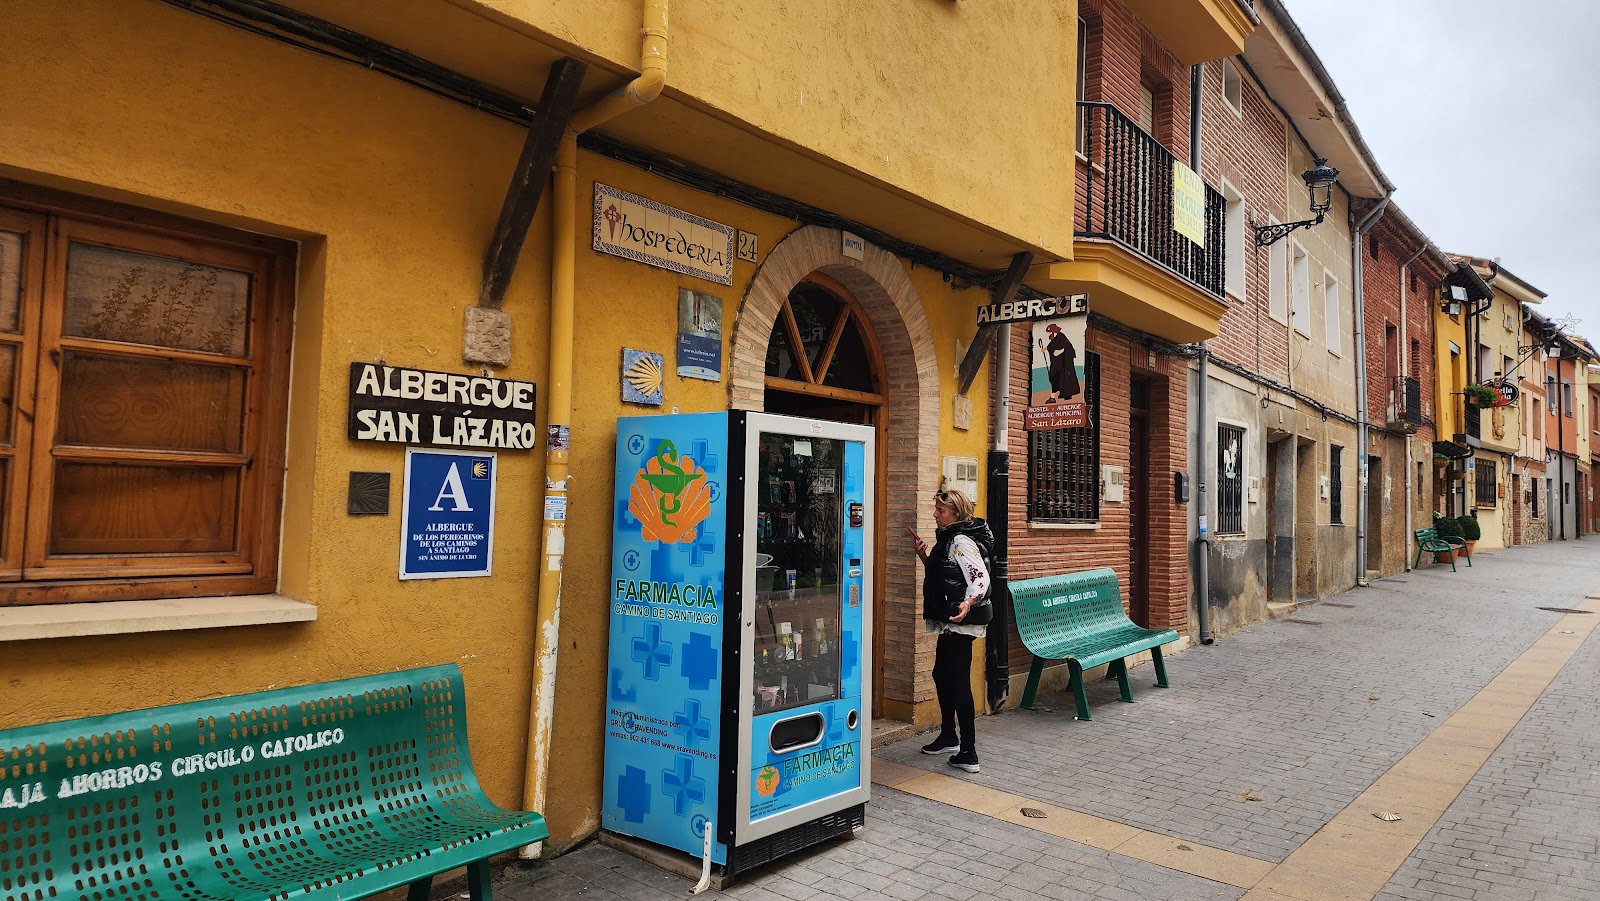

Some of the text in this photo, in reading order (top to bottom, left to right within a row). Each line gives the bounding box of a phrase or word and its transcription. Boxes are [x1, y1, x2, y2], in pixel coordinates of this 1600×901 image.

[738, 233, 756, 260] 24
[977, 293, 1086, 323] ALBERGUE
[356, 365, 533, 410] ALBERGUE
[357, 409, 420, 443] SAN
[432, 410, 535, 449] LÁZARO
[1031, 418, 1081, 428] San Lázaro
[428, 461, 473, 512] A
[425, 523, 474, 532] ALBERGUE
[440, 533, 484, 541] PEREGRINOS
[615, 579, 718, 609] FARMACIA
[614, 603, 718, 625] CAMINO DE SANTIAGO
[610, 731, 629, 740] ventas:
[631, 723, 668, 737] ERAVENDING
[669, 721, 681, 730] por:
[57, 761, 163, 799] AHORROS
[171, 745, 255, 777] CIRCULO
[261, 727, 345, 760] CATOLICO
[783, 742, 854, 778] FARMACIA
[783, 761, 855, 789] CAMINO DE SANTIAGO
